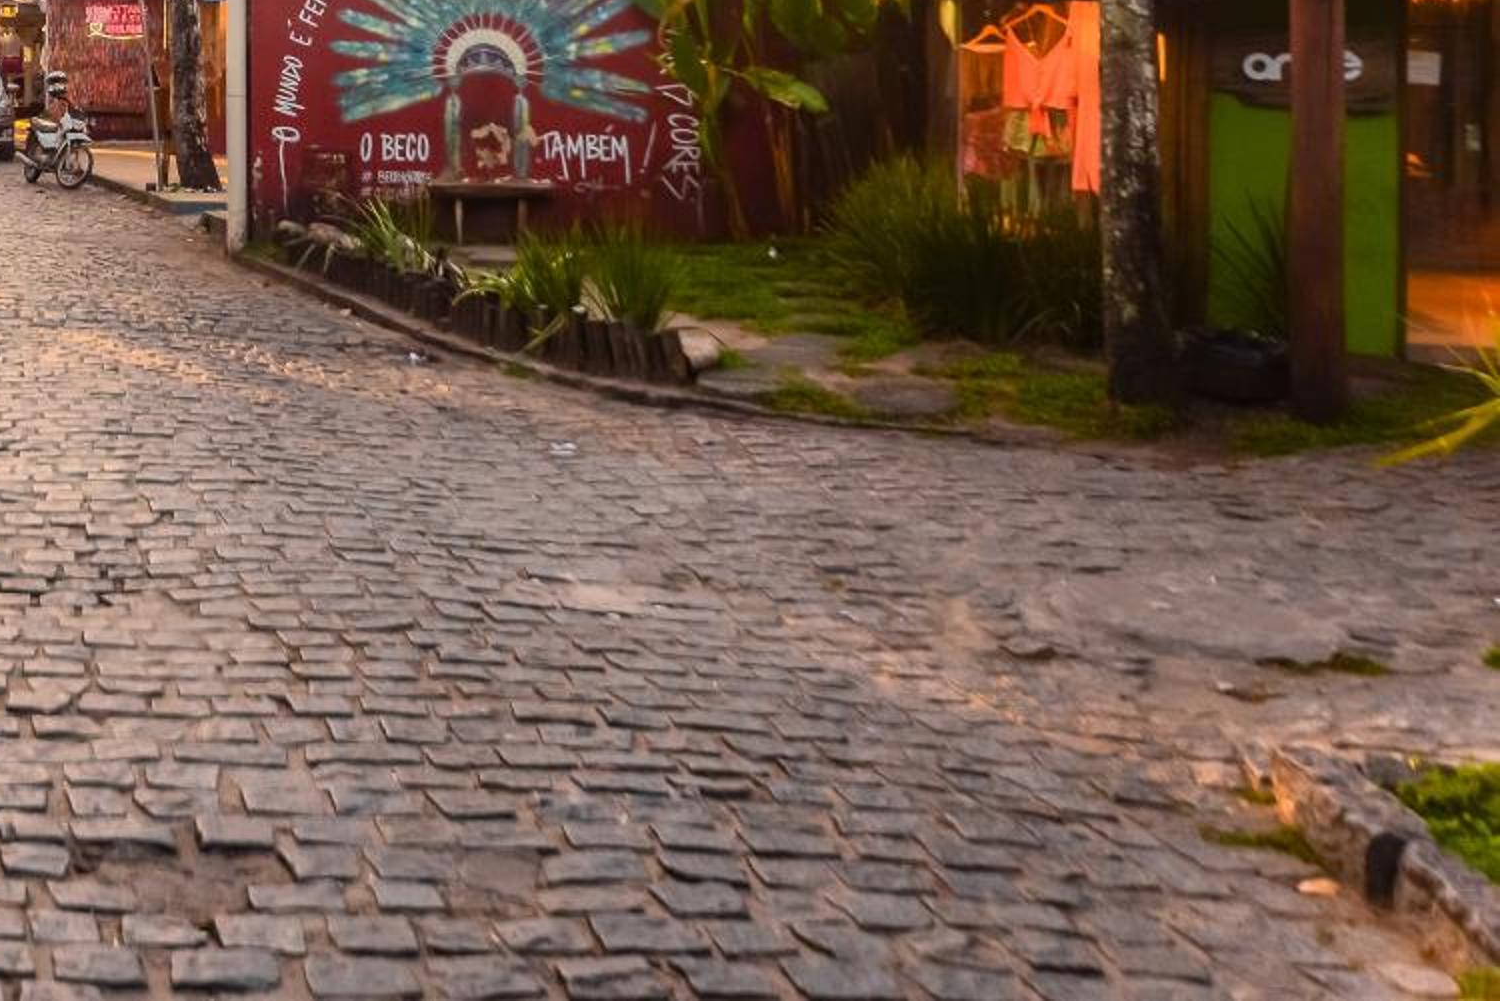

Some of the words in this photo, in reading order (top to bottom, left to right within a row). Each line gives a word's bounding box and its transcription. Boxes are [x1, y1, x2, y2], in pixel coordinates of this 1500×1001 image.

[272, 54, 305, 118] MUNDO
[360, 132, 373, 163] O
[380, 132, 430, 163] BECO
[662, 112, 702, 201] CORES
